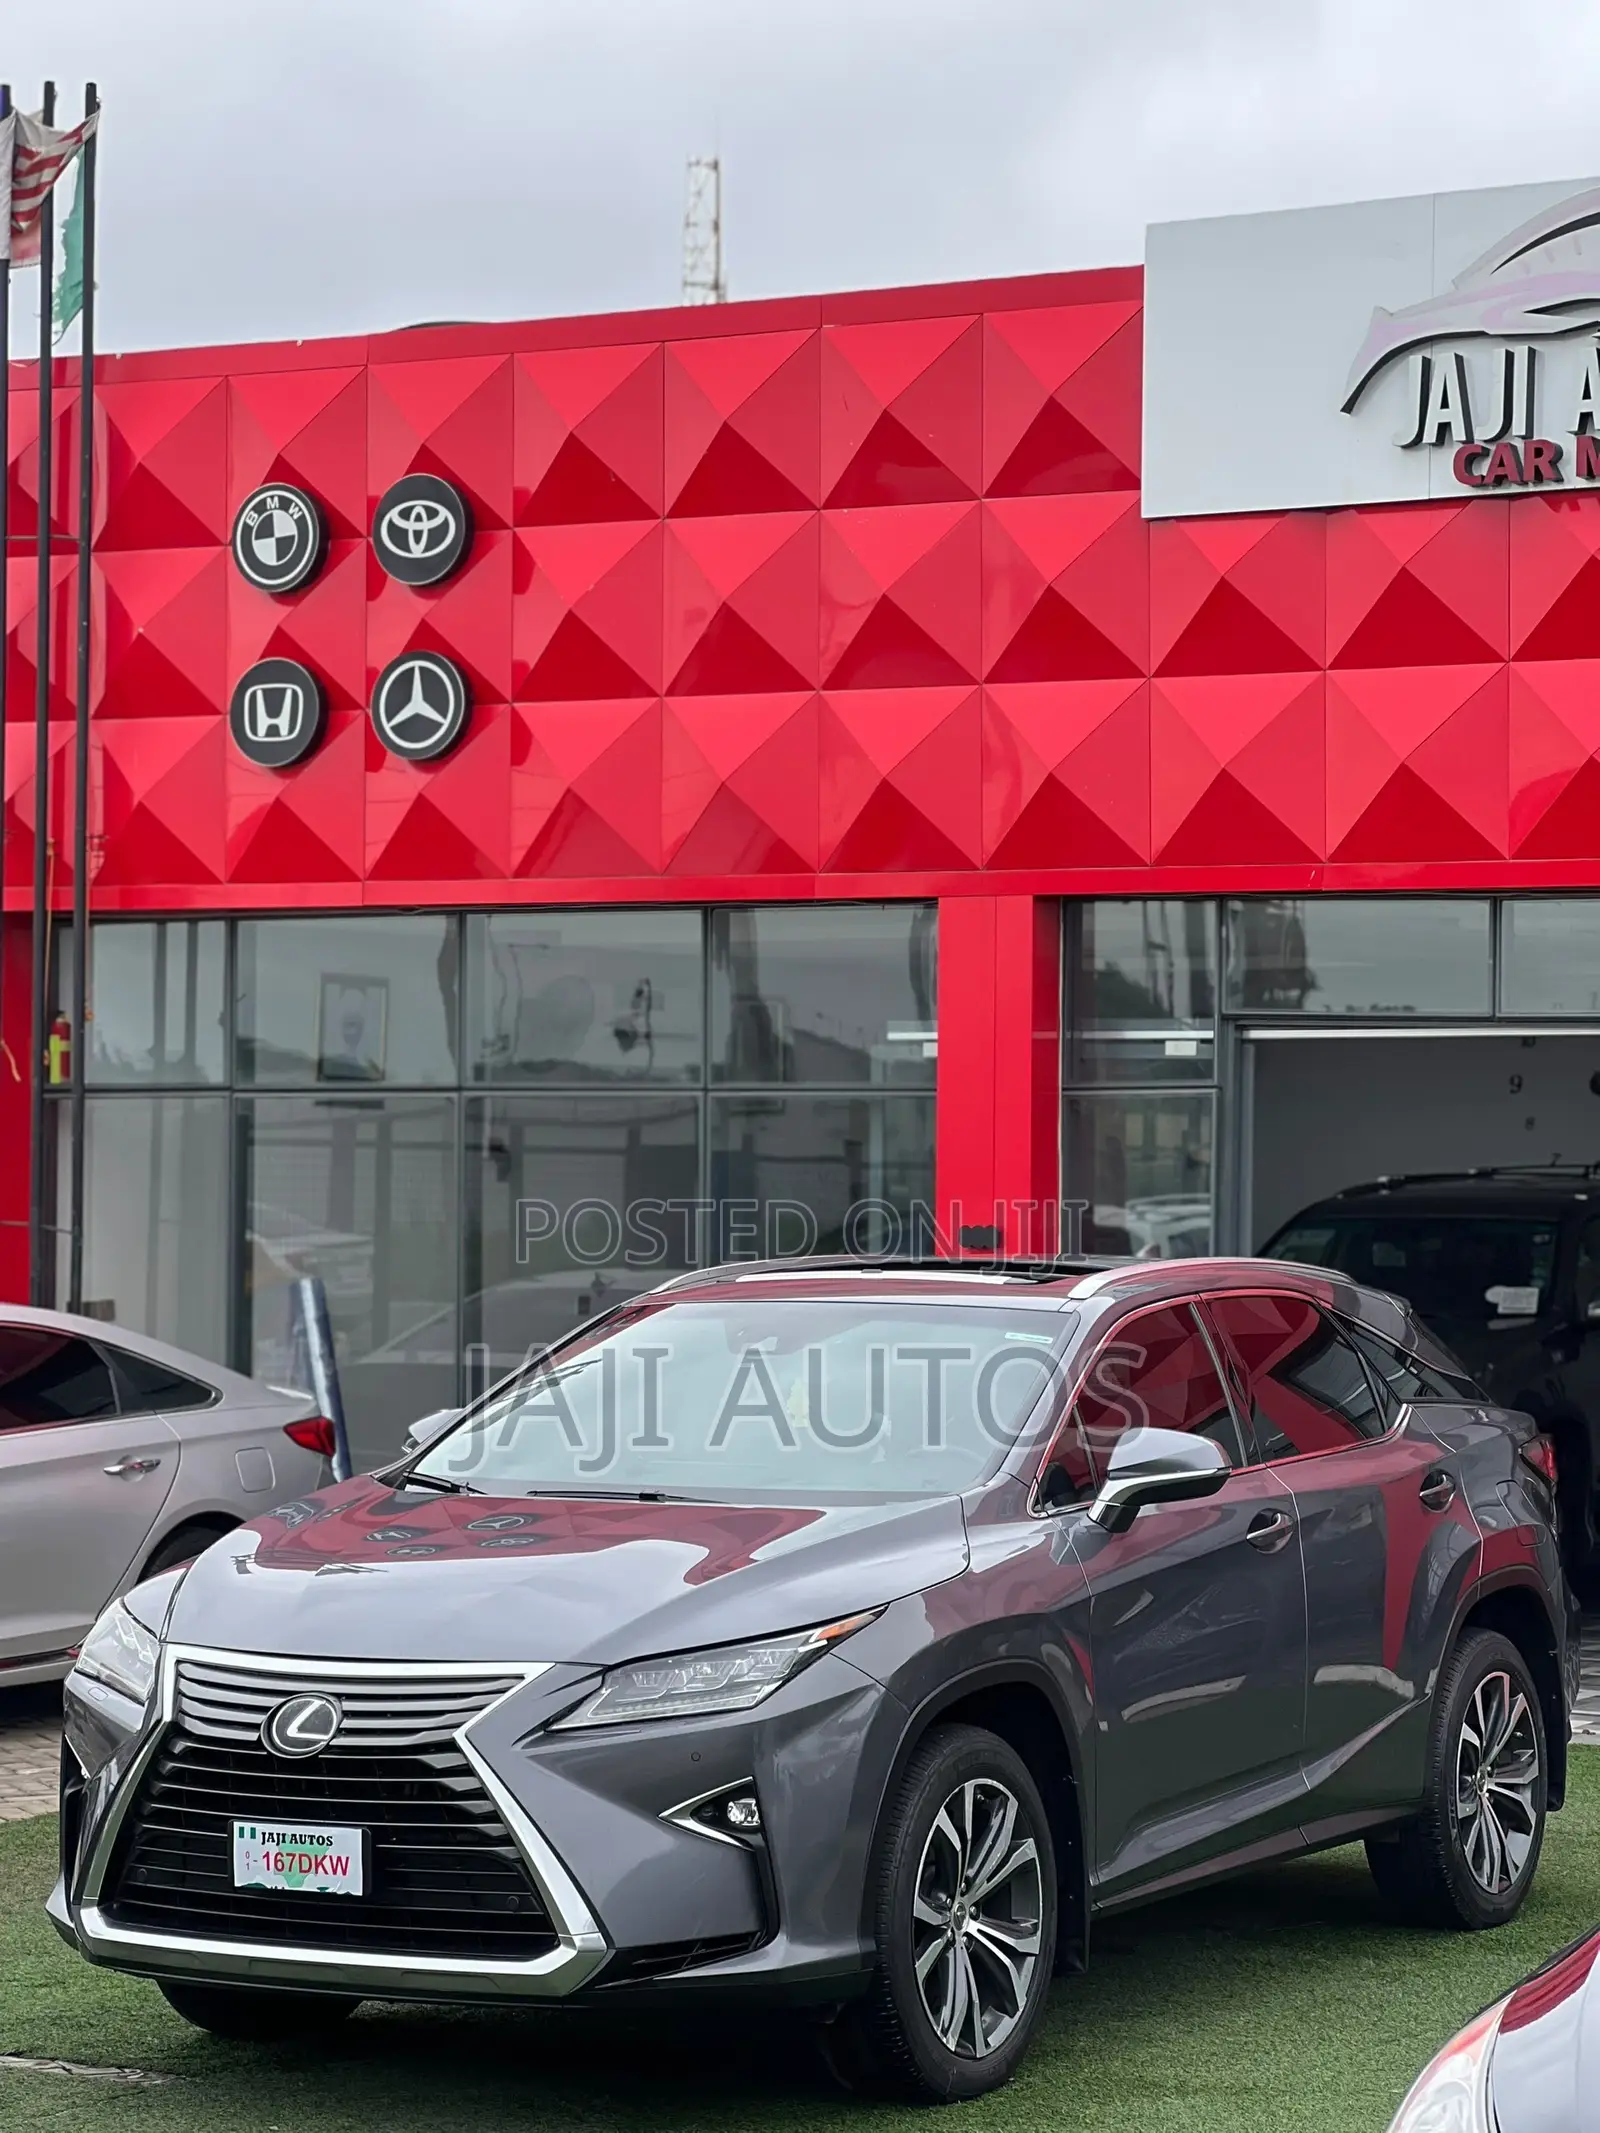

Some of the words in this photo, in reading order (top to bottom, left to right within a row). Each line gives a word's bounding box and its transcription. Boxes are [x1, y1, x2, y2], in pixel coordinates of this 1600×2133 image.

[1393, 345, 1536, 449] JAJI
[1453, 439, 1563, 487] CAR
[246, 496, 303, 527] BMW
[1509, 1073, 1523, 1095] 9
[261, 1831, 287, 1847] JAJI
[289, 1833, 334, 1847] AUTOS
[262, 1850, 350, 1877] 167DKW
